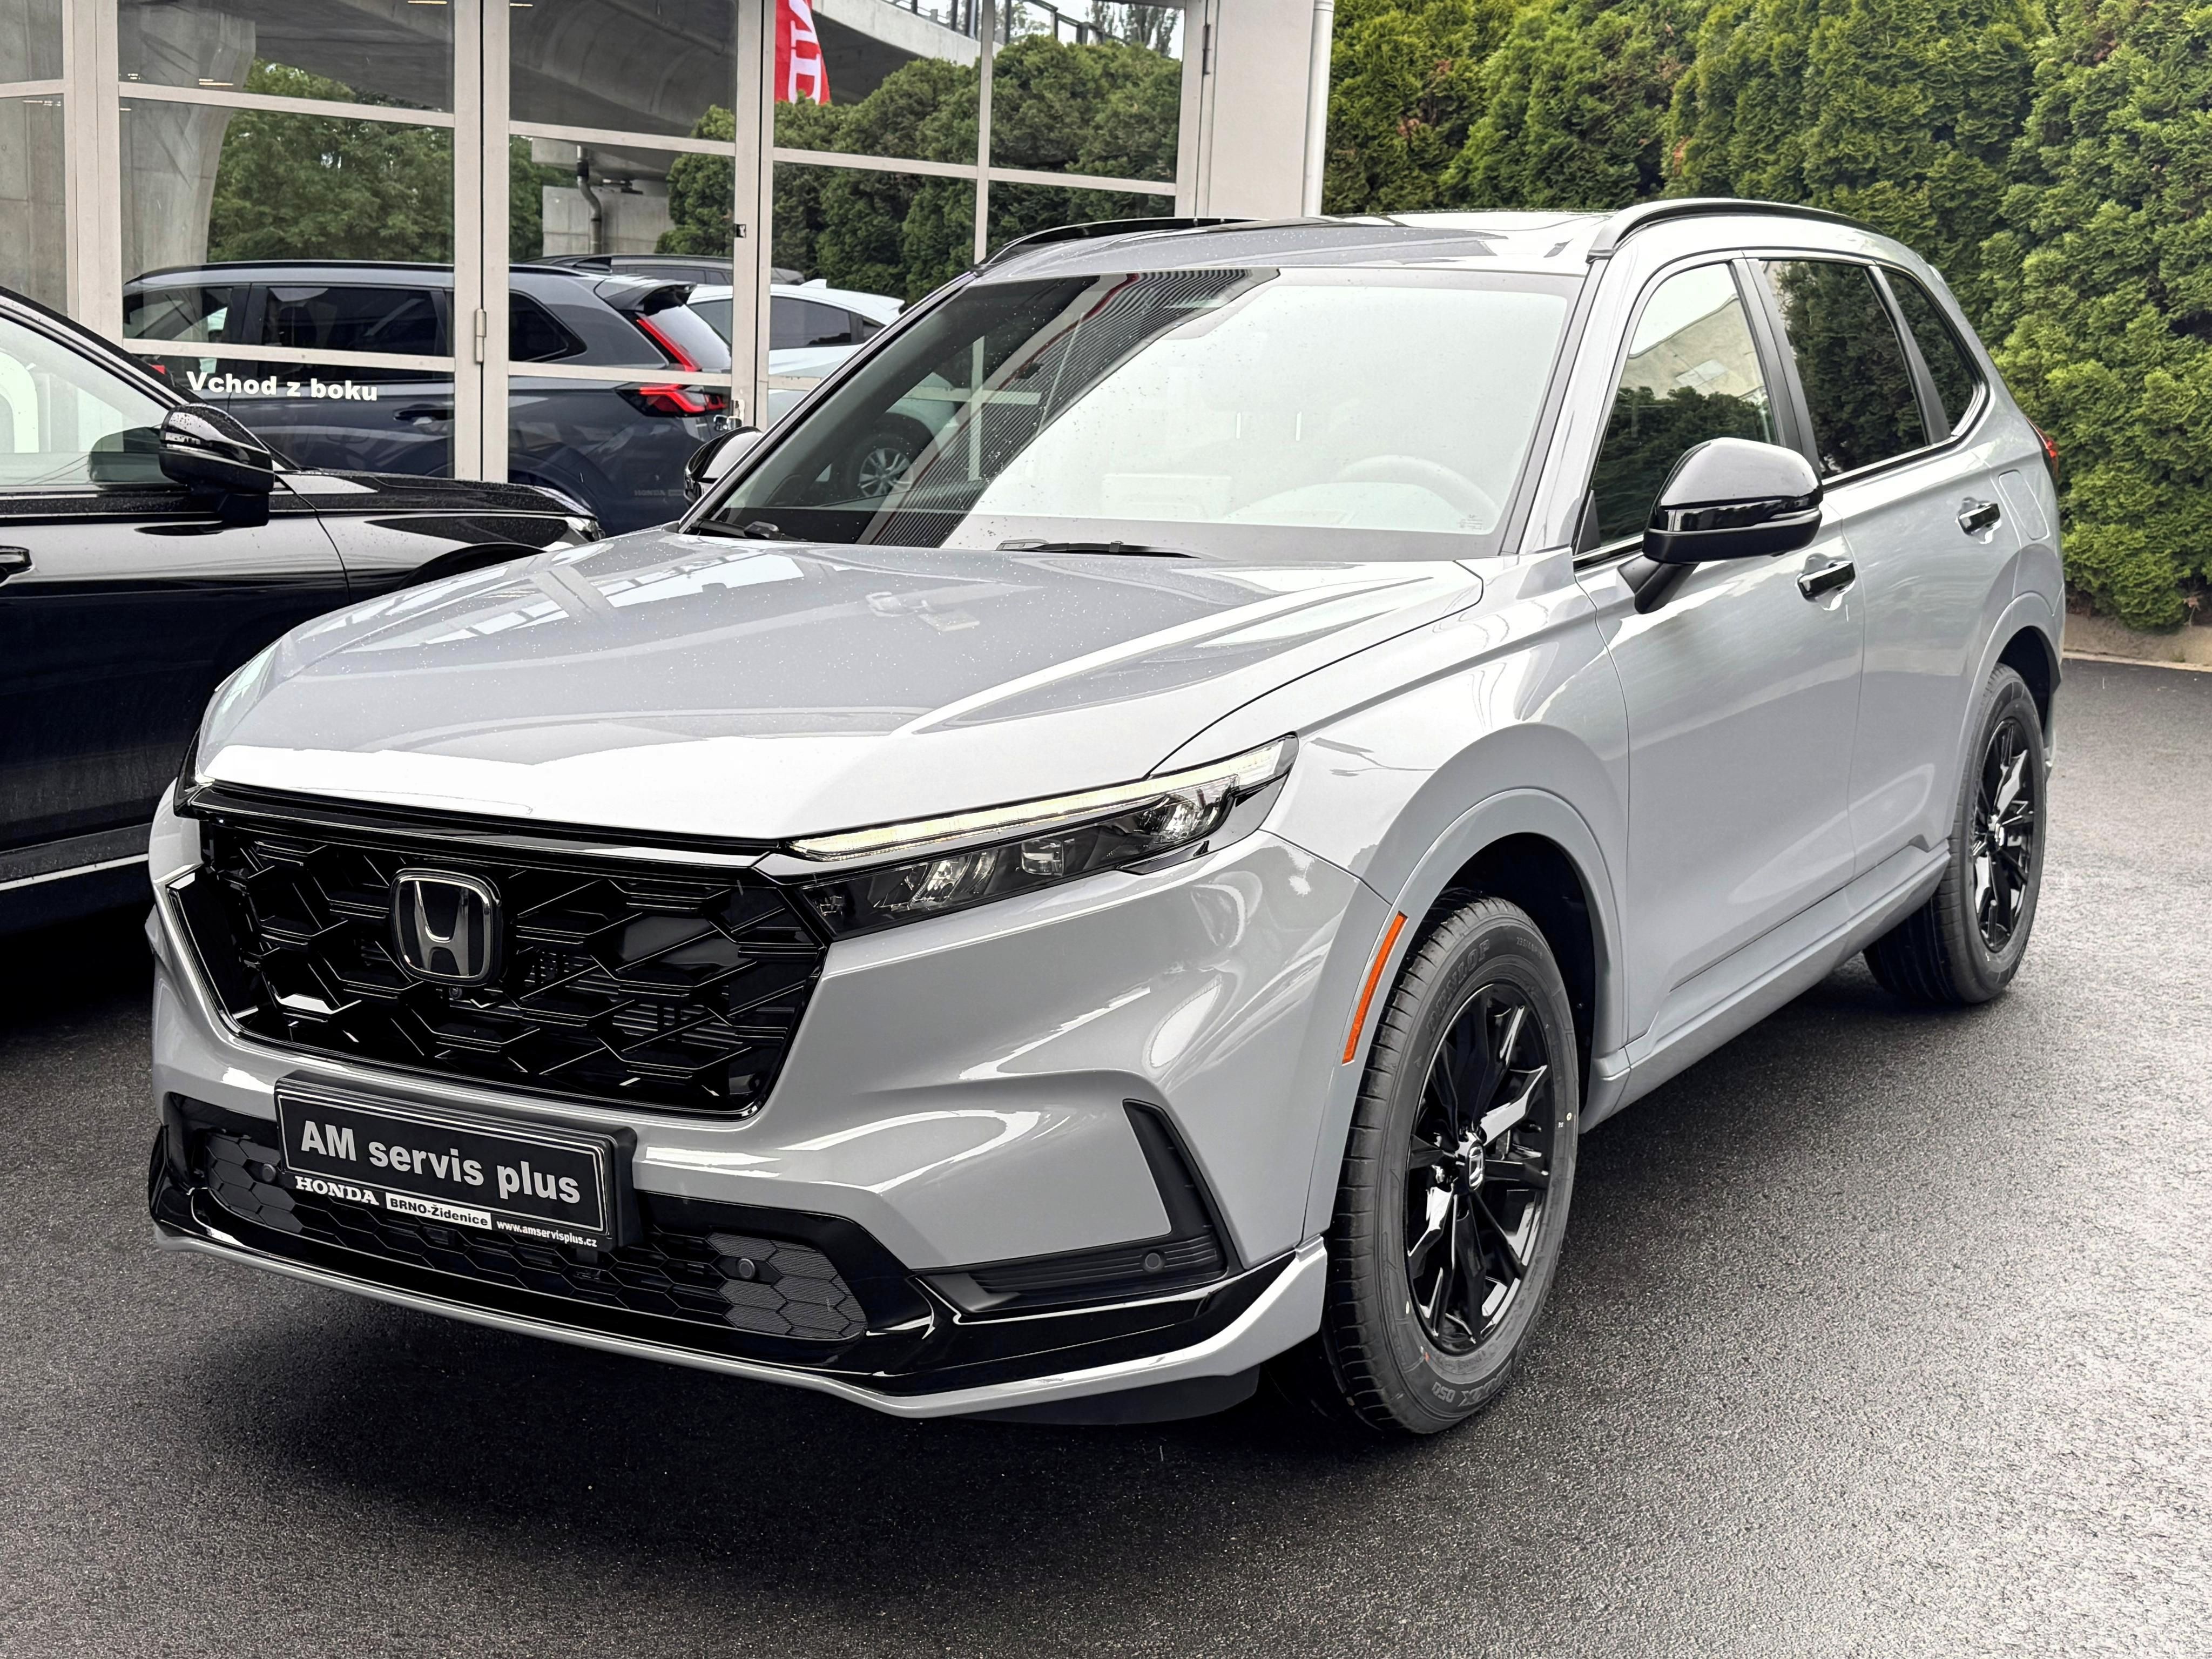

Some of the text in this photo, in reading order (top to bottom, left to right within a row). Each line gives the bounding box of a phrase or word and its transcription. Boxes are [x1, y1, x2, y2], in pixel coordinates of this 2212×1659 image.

[186, 371, 377, 401] Vchod z boku
[1426, 939, 1491, 1041] DUNLOP
[301, 1120, 581, 1204] AM servis plus
[295, 1176, 380, 1205] HONDA
[390, 1198, 488, 1226] BRNO-Židenice
[496, 1220, 597, 1247] www.amservisplus.cz
